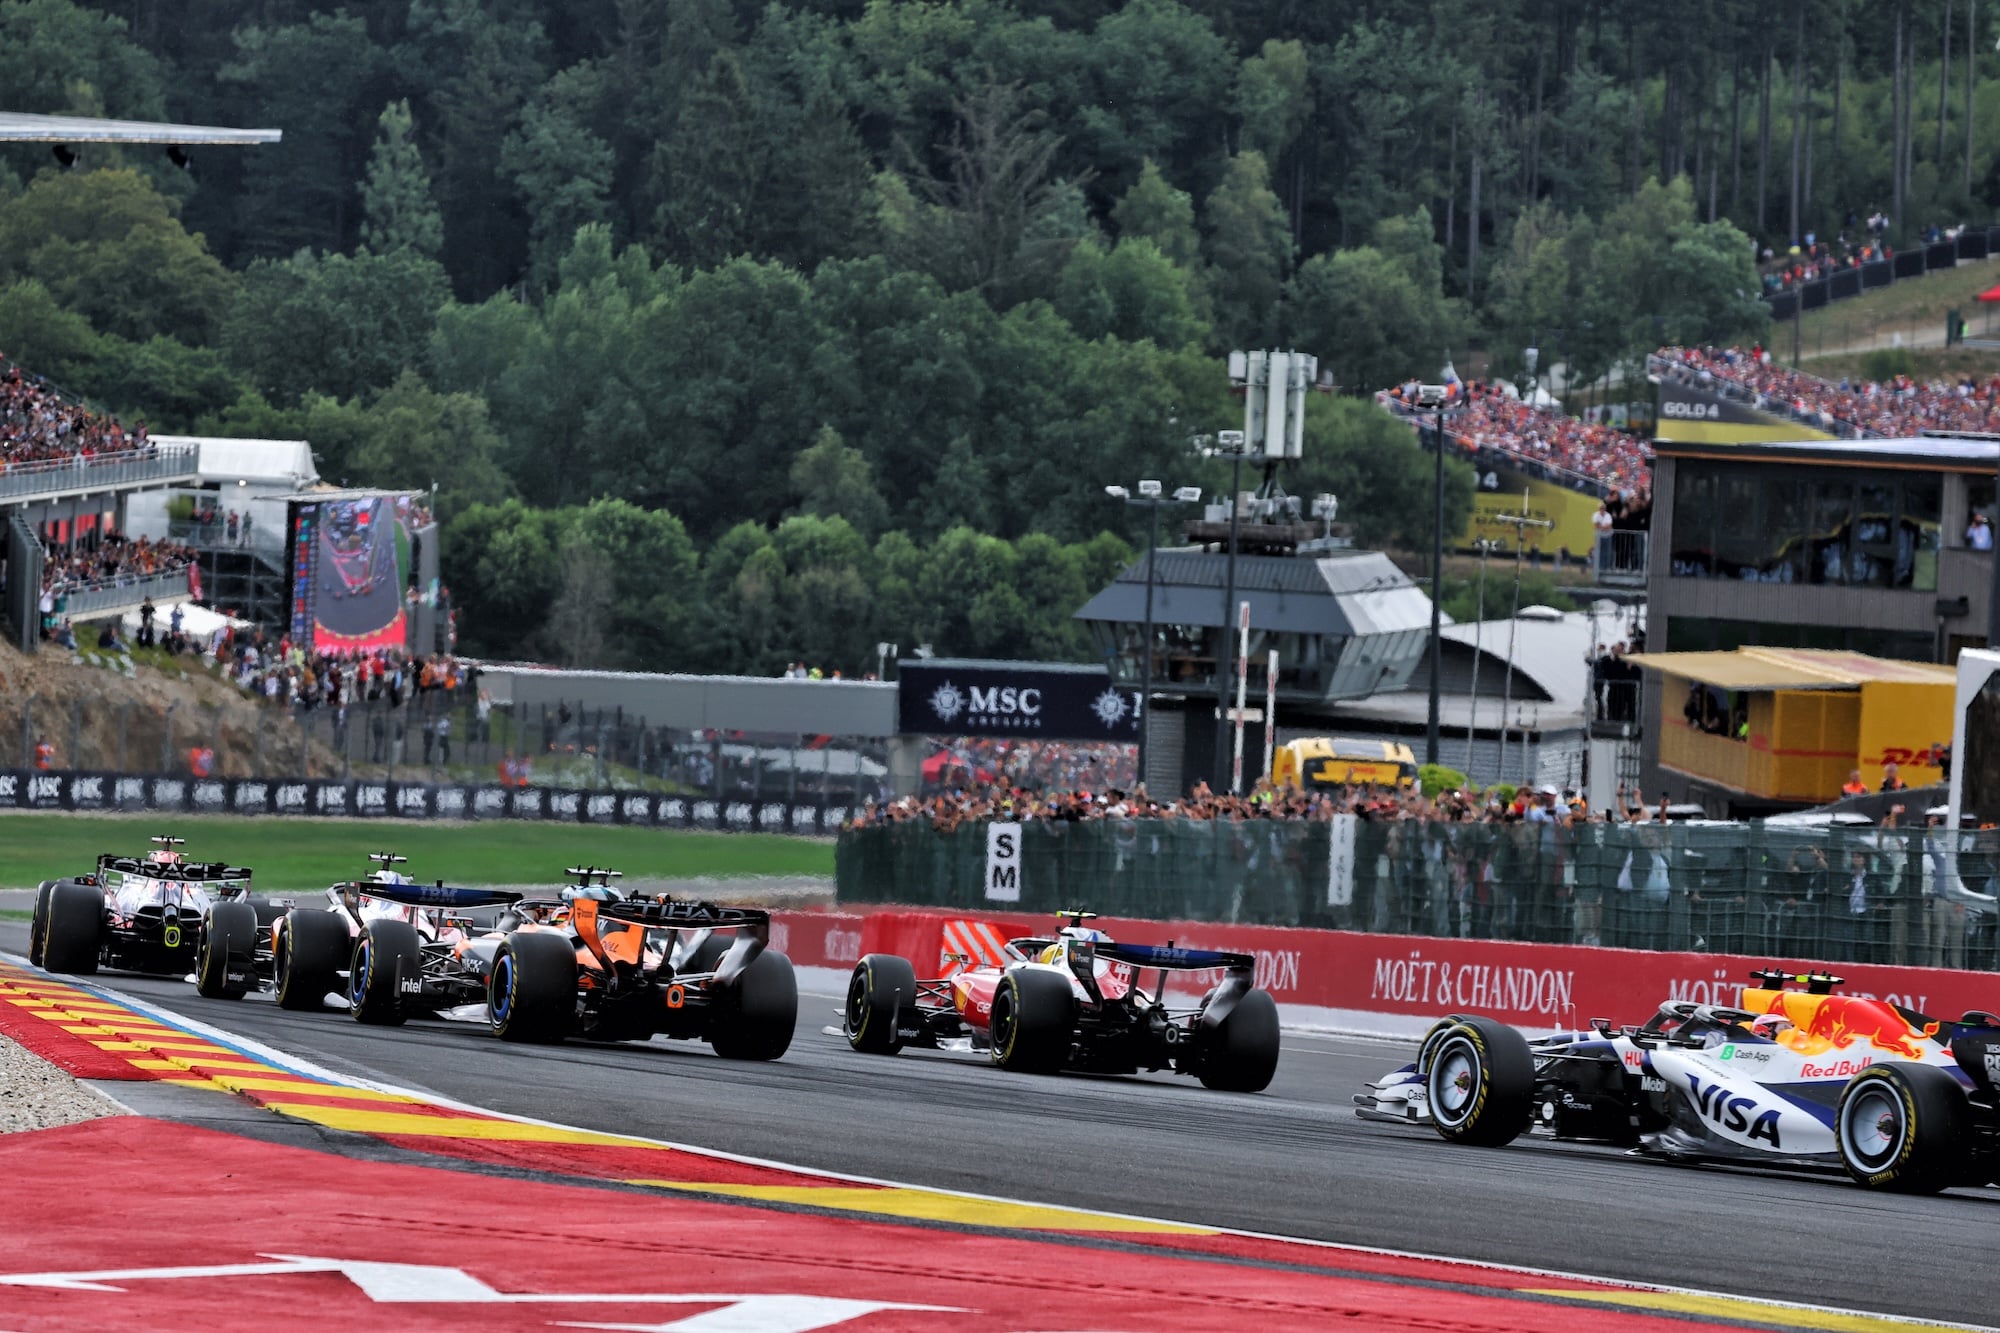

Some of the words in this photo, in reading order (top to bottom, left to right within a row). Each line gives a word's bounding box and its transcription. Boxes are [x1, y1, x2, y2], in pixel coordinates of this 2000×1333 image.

[1663, 401, 1706, 418] GOLD
[1707, 403, 1719, 418] 4
[968, 685, 1041, 716] MSC
[1880, 748, 1931, 768] DH
[113, 854, 242, 879] ORACLE
[420, 886, 458, 903] IBM
[610, 902, 746, 920] ETIHAD
[1151, 946, 1189, 963] IBM
[401, 977, 423, 993] intel
[1371, 951, 1437, 1003] MOËT
[1436, 962, 1453, 1006] &
[1456, 964, 1575, 1014] CHANDON
[1735, 1050, 1753, 1060] Cash
[1753, 1052, 1770, 1063] App
[1801, 1062, 1838, 1078] Red
[1838, 1057, 1873, 1076] Bull
[1641, 1076, 1667, 1093] Mobil
[1685, 1072, 1782, 1149] VISA
